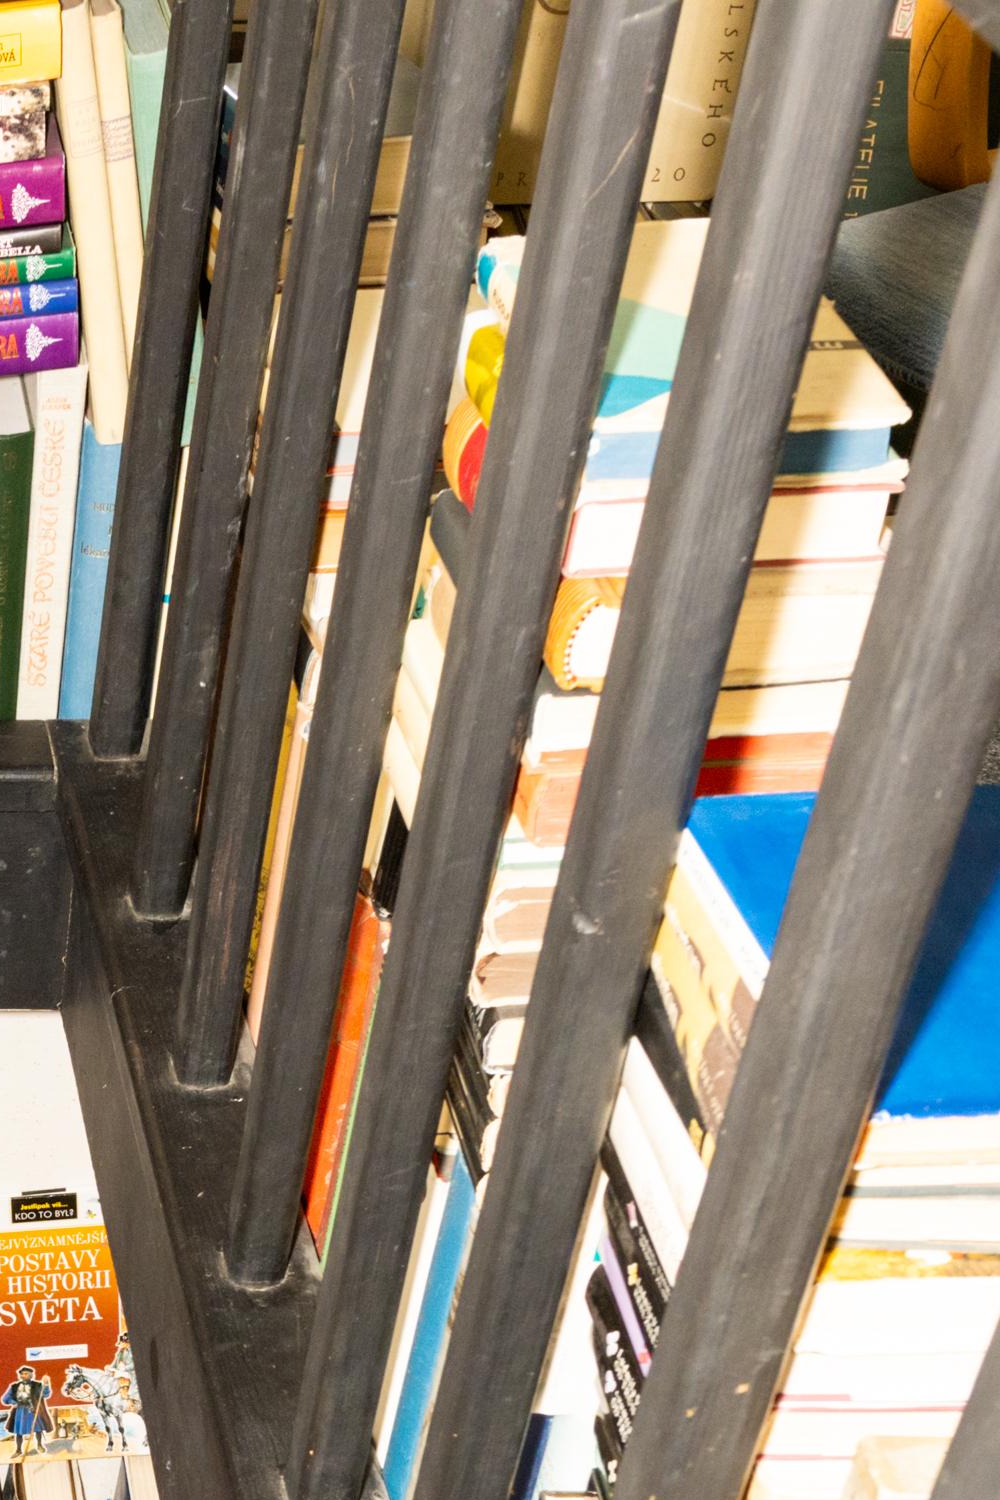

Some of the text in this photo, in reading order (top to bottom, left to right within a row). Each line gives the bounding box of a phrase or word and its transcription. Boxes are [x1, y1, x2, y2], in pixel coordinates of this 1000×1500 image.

[14, 1208, 75, 1221] KDO TO BYL?
[7, 1269, 112, 1296] HISTORII
